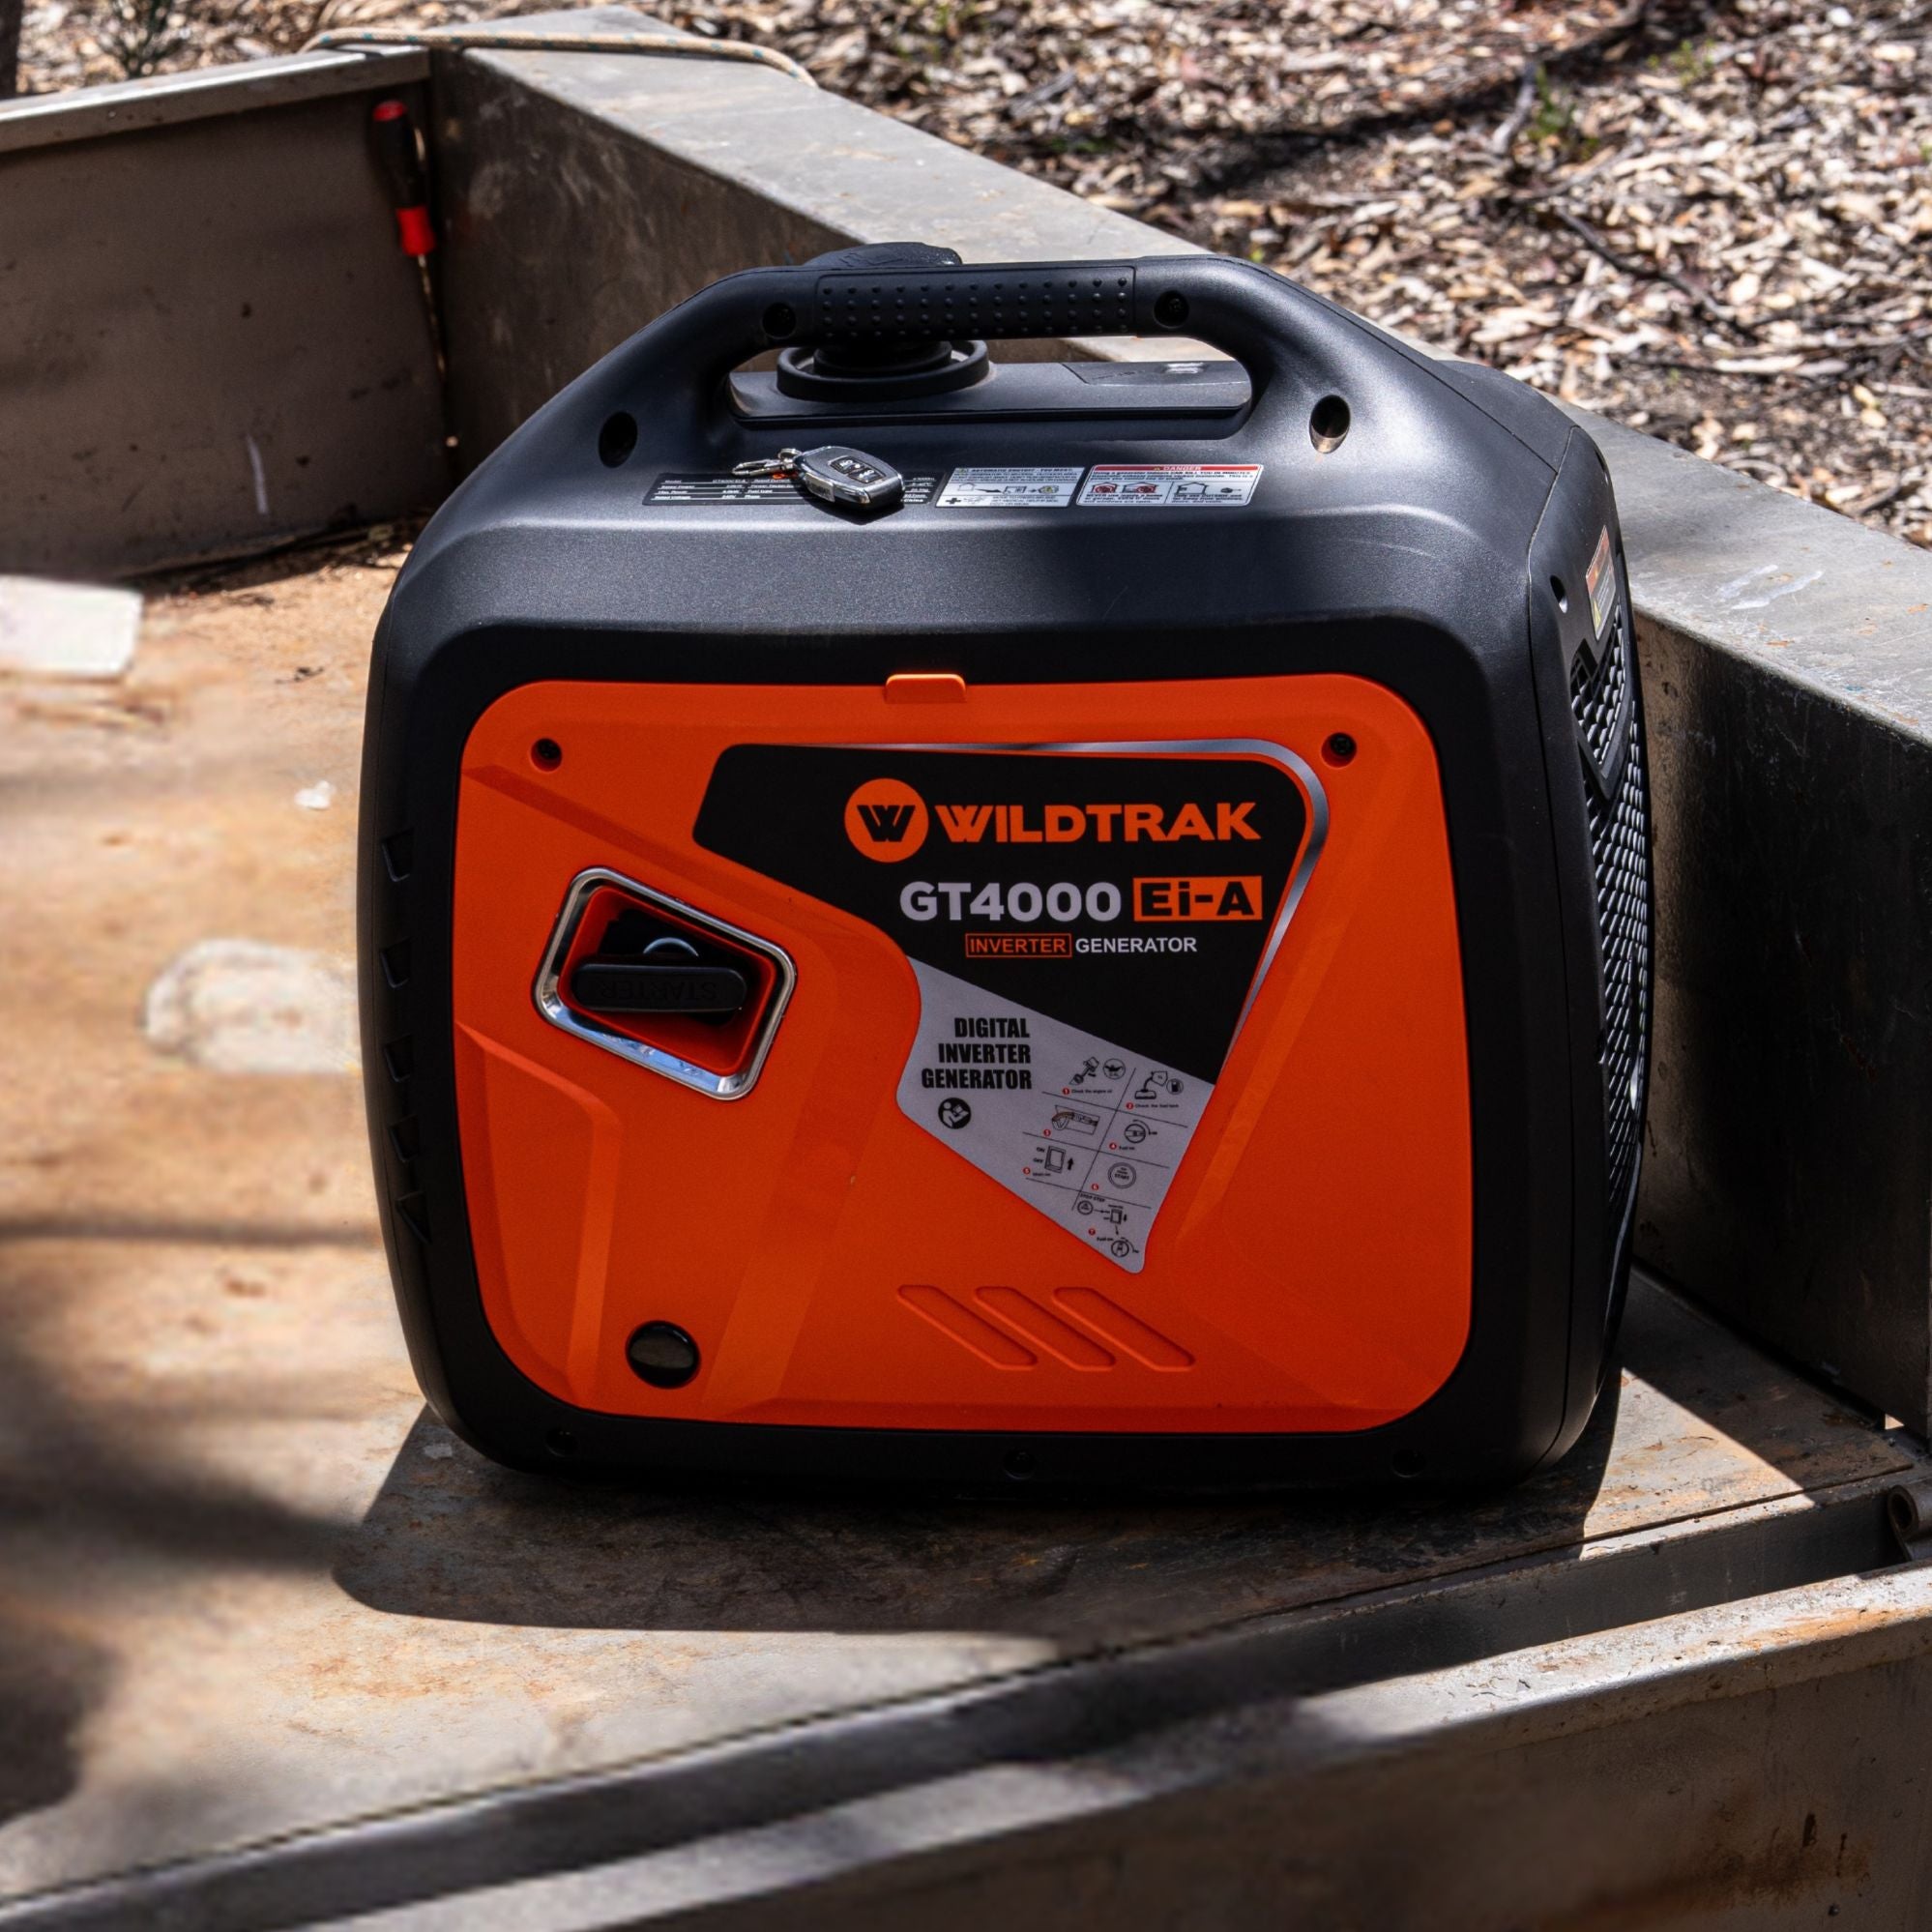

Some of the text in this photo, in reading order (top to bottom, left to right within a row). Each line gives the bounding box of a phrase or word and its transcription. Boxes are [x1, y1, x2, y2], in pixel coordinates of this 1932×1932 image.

[934, 803, 1262, 843] WILDTRAK
[899, 882, 1255, 922] GT4000 Ei-A
[969, 937, 1197, 954] INVERTER GENERATOR
[600, 981, 717, 1001] STARTER
[954, 1017, 1031, 1039] DIGITAL
[938, 1043, 1032, 1065] INVERTER
[922, 1068, 1033, 1090] GENERATOR
